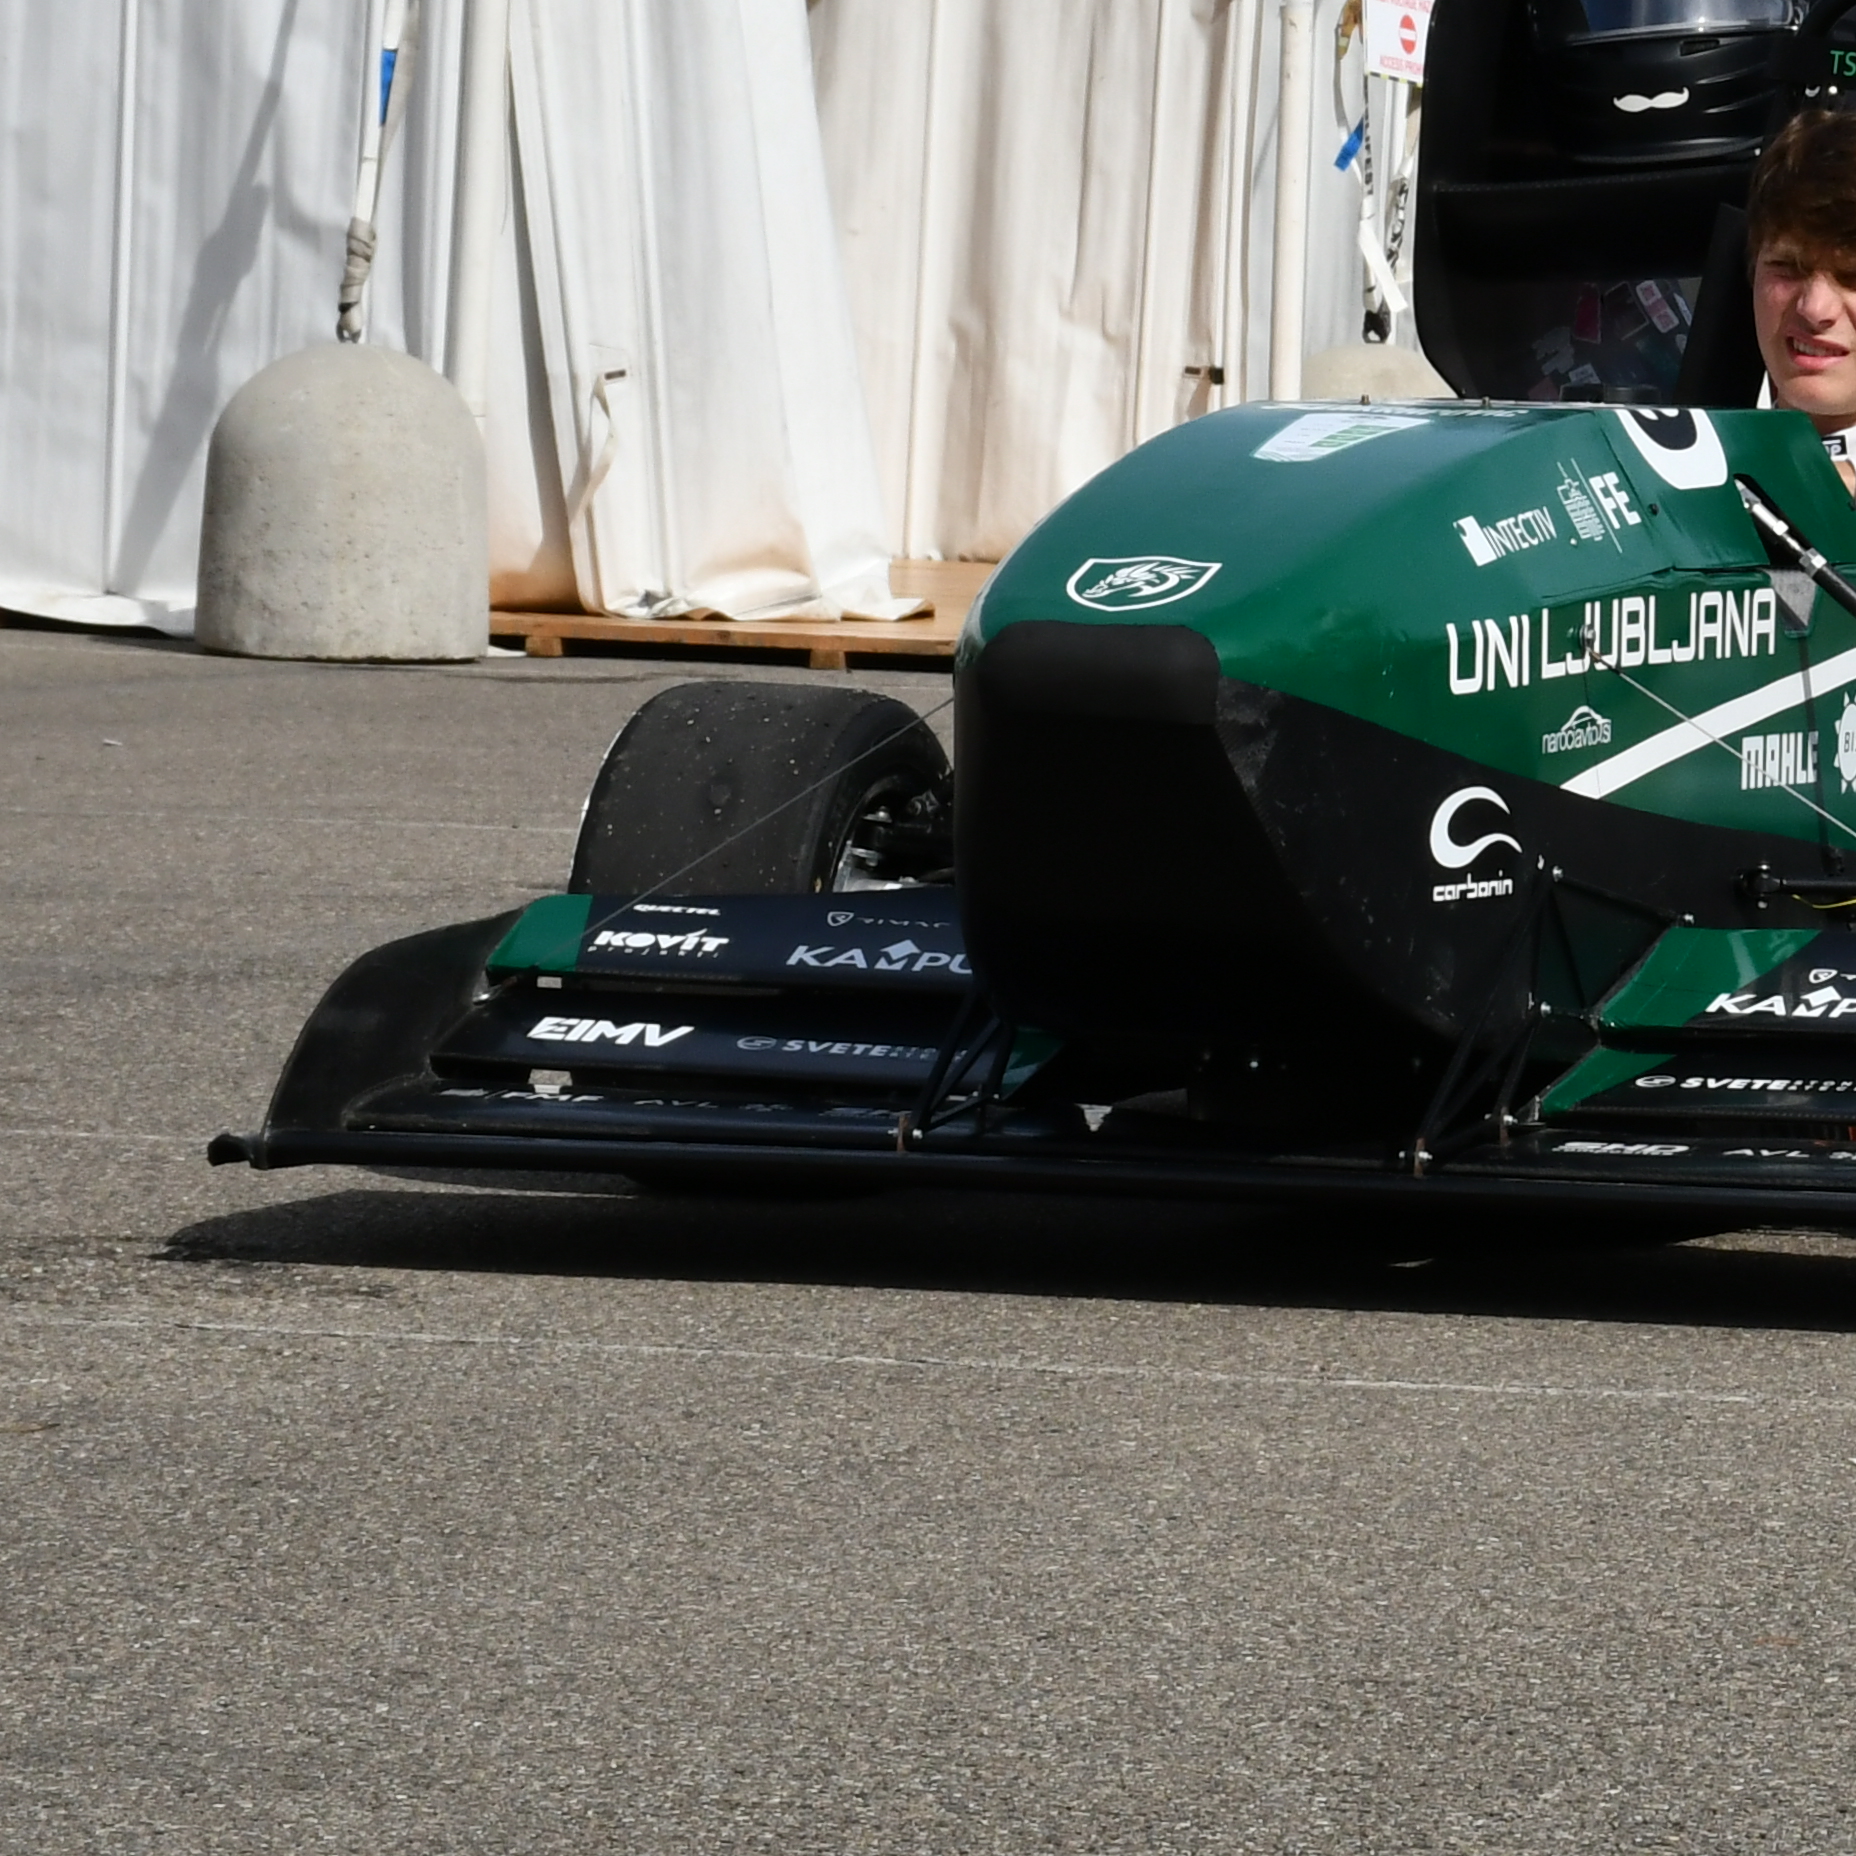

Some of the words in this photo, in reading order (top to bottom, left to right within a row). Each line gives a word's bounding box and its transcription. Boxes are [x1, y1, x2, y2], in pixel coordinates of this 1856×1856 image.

[1588, 471, 1642, 530] FE
[1482, 506, 1558, 559] INTECTIV
[1446, 614, 1530, 695] UNI
[1541, 588, 1777, 680] LJUBLJANA
[1740, 730, 1820, 791] MAHLE
[1432, 871, 1514, 903] carbonin
[785, 938, 975, 975] KAMPU
[527, 1016, 695, 1048] EIMV
[1680, 1076, 1787, 1092] SVETE
